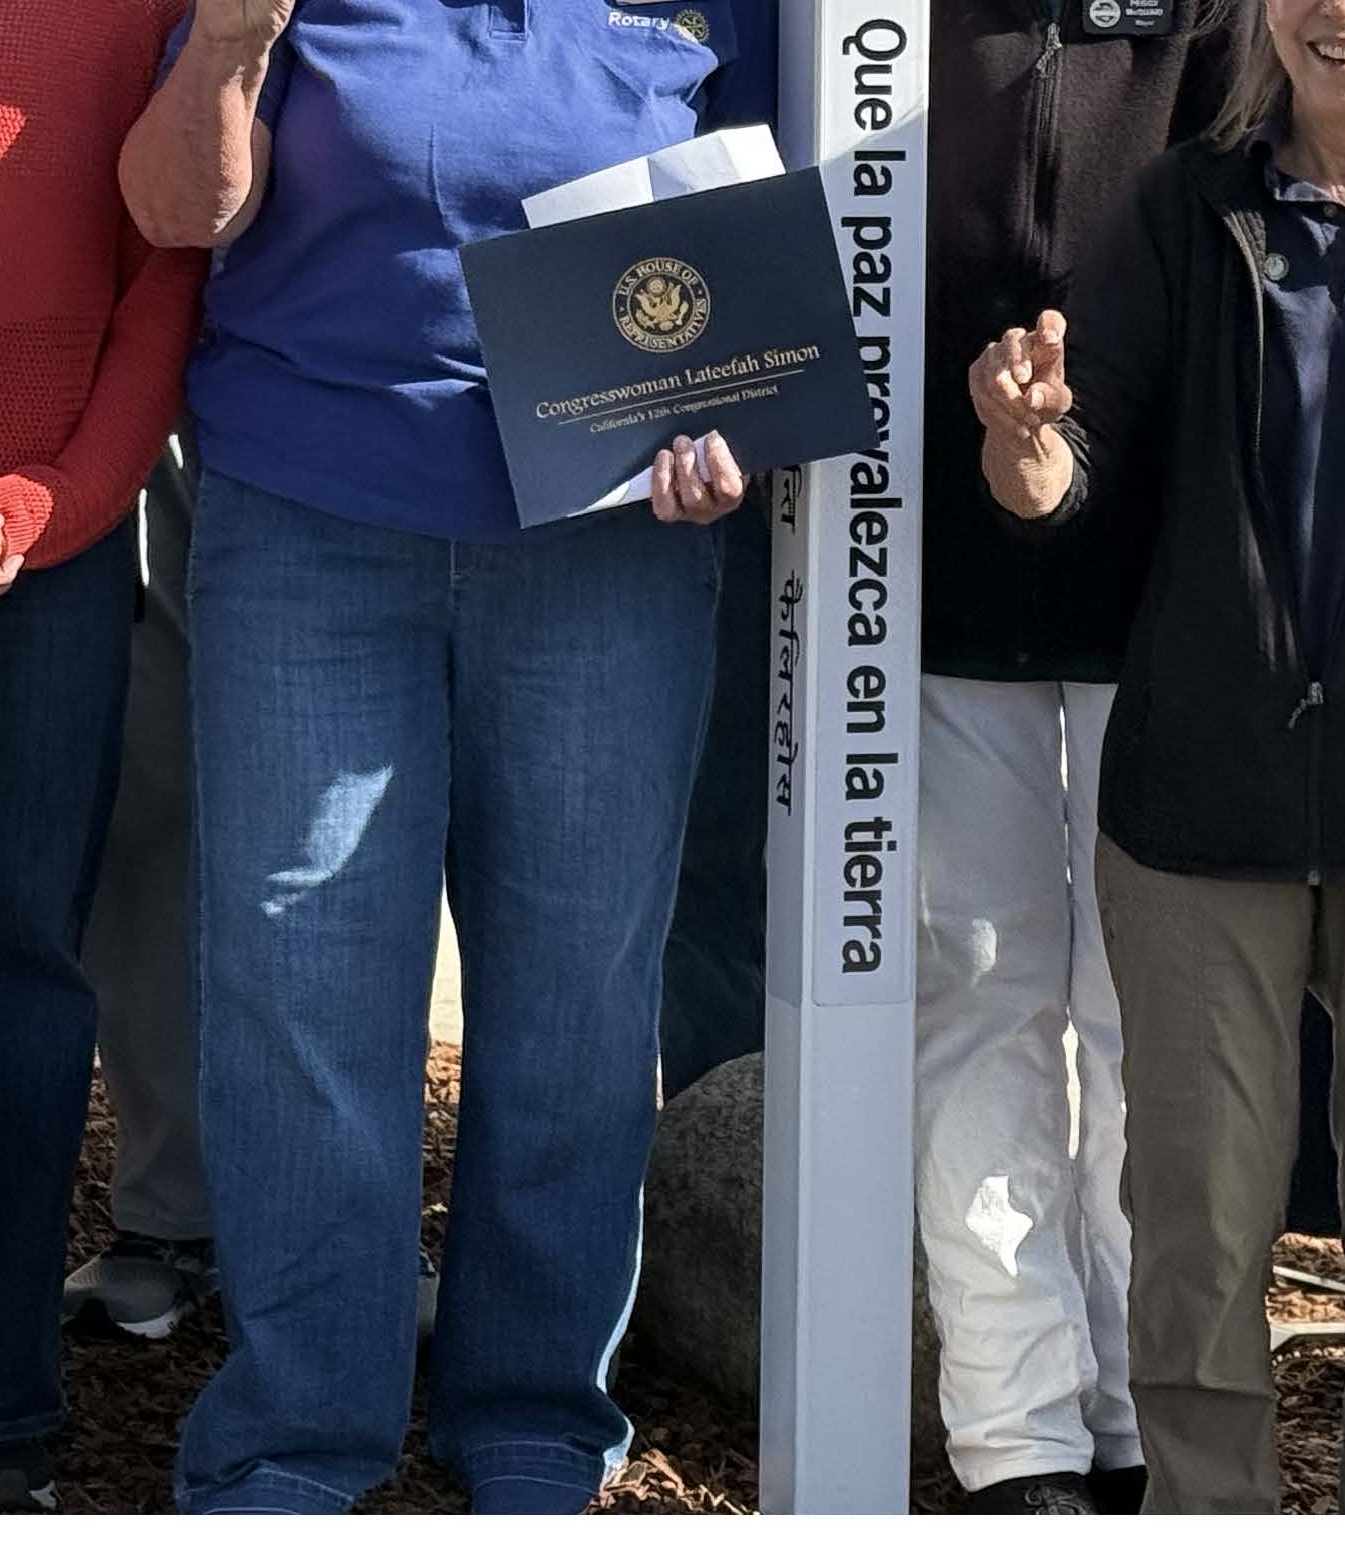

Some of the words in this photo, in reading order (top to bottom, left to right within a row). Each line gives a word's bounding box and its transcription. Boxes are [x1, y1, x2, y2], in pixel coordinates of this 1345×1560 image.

[608, 11, 670, 30] Rotary
[842, 19, 908, 131] Que
[853, 150, 906, 196] la
[636, 260, 682, 277] HOUSE
[681, 269, 699, 285] OF
[841, 217, 893, 317] paz
[536, 375, 681, 419] Congresswoman
[685, 354, 760, 386] Lateefah
[764, 344, 822, 369] Simon
[846, 664, 886, 733] en
[845, 753, 898, 800] la
[842, 816, 896, 974] tierra
